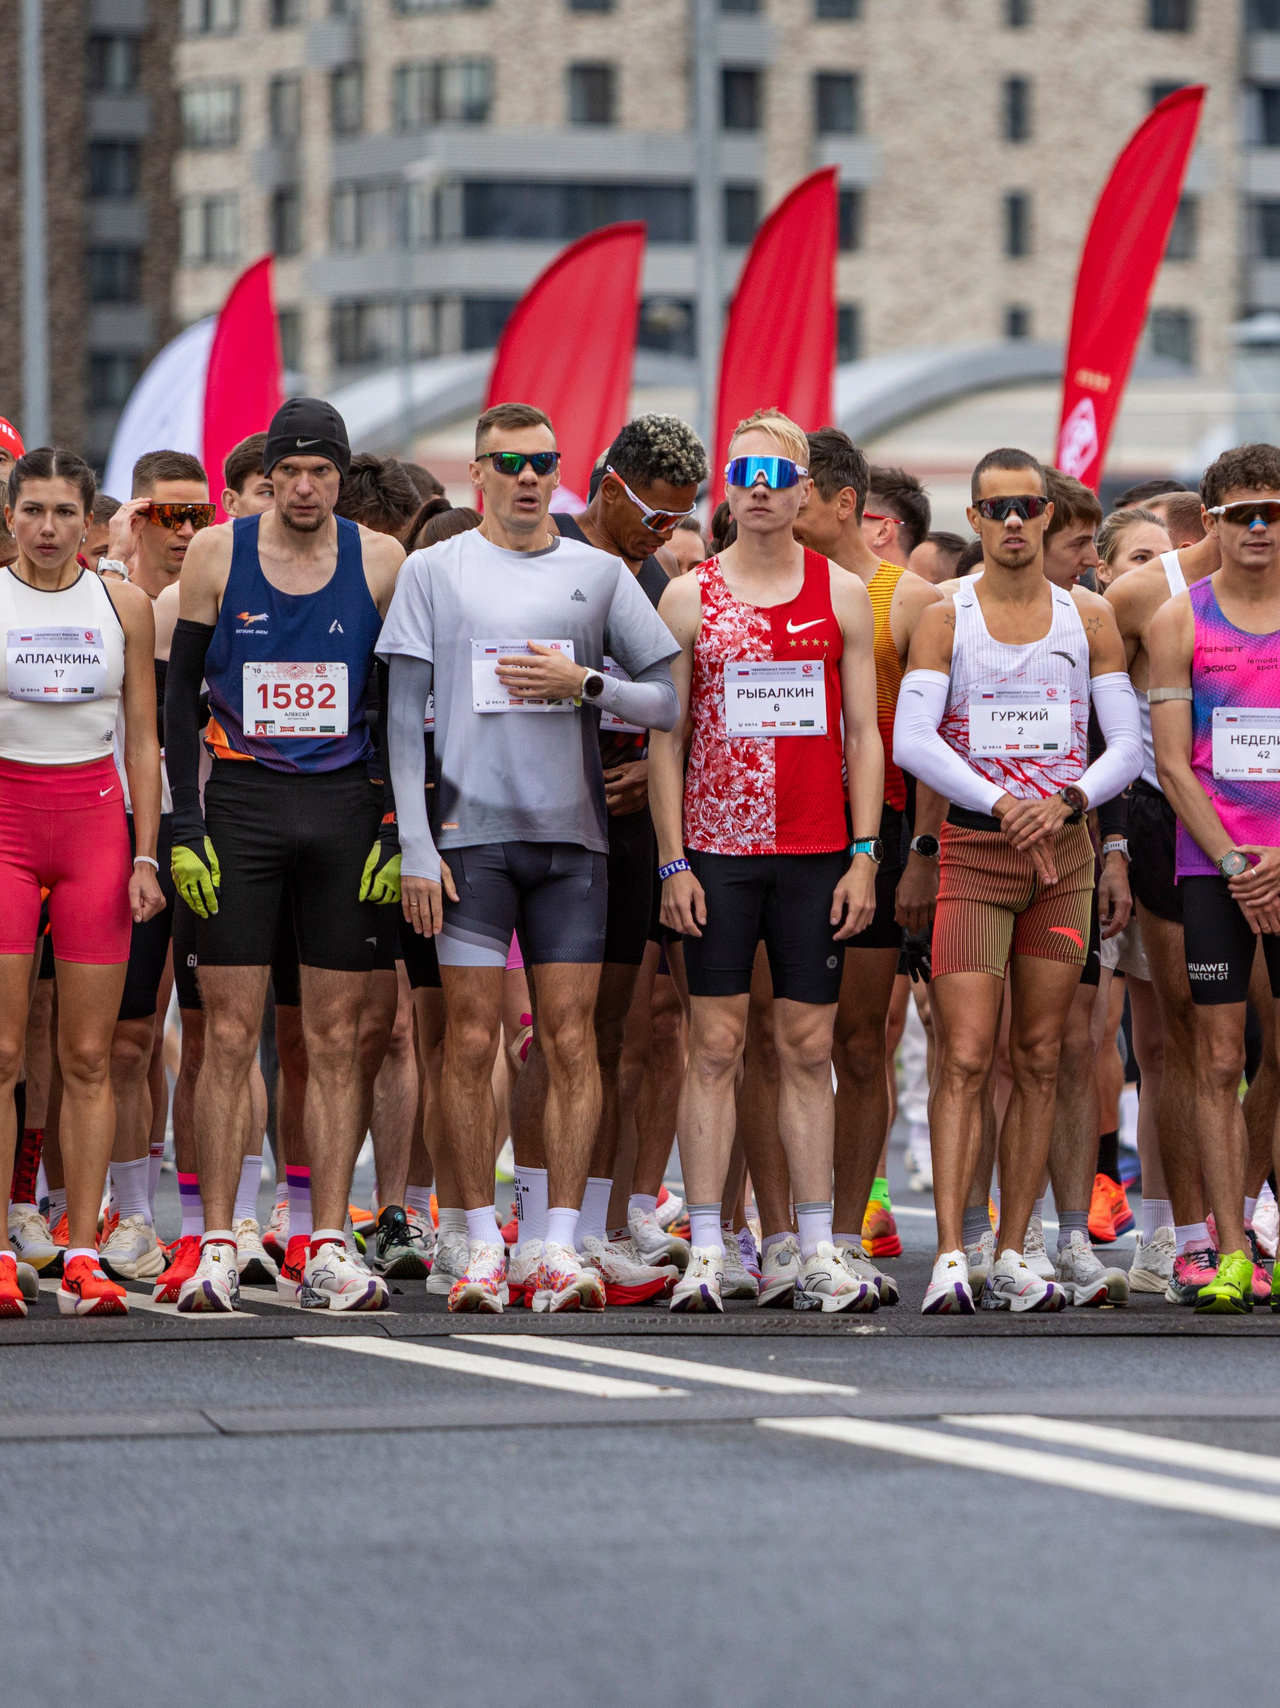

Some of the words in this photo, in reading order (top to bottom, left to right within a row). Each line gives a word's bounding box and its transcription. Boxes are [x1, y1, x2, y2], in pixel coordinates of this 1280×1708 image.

[15, 654, 100, 664] АПЛАЧКИНА
[257, 683, 336, 709] 1582
[737, 688, 813, 698] РЫБАЛКИН
[992, 708, 1048, 721] ГУРЖИЙ
[1258, 751, 1270, 759] 42
[1188, 963, 1228, 972] HUAWEI
[1190, 972, 1215, 981] WATCH
